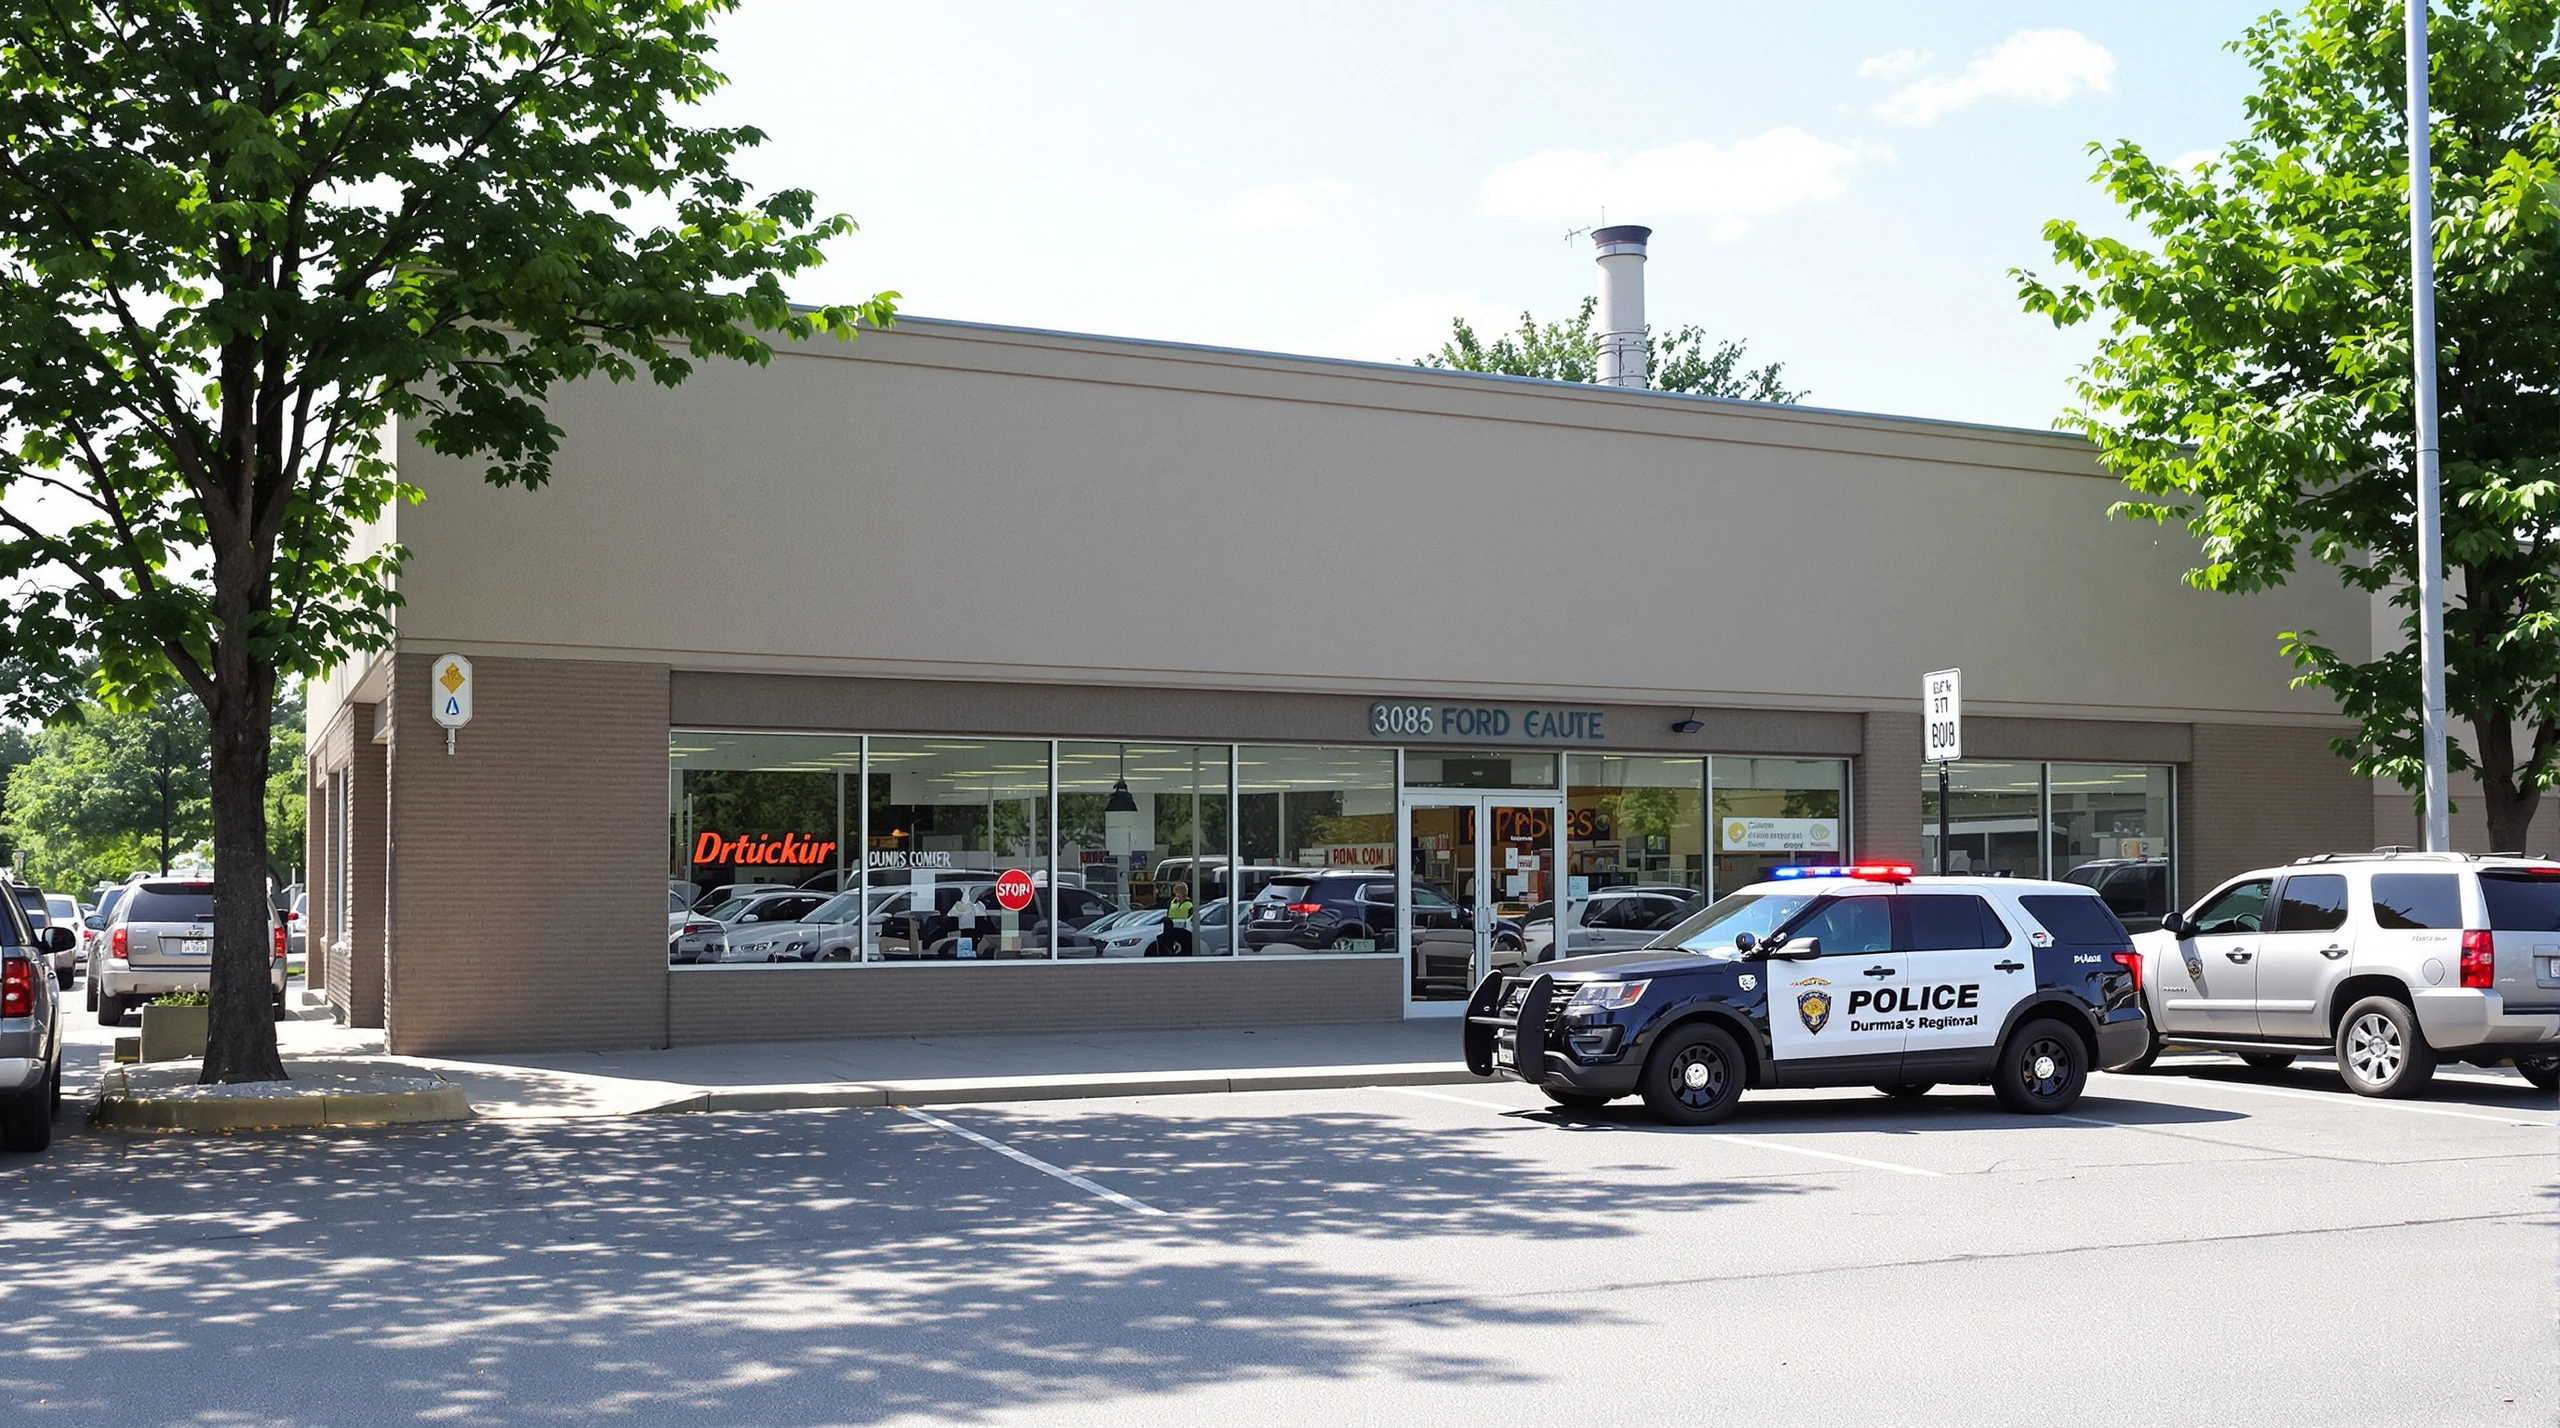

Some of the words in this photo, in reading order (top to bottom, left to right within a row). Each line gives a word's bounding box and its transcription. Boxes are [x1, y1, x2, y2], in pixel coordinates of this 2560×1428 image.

[1372, 704, 1434, 735] 3085
[1441, 708, 1510, 736] FORD
[1847, 984, 1980, 1015] POLICE
